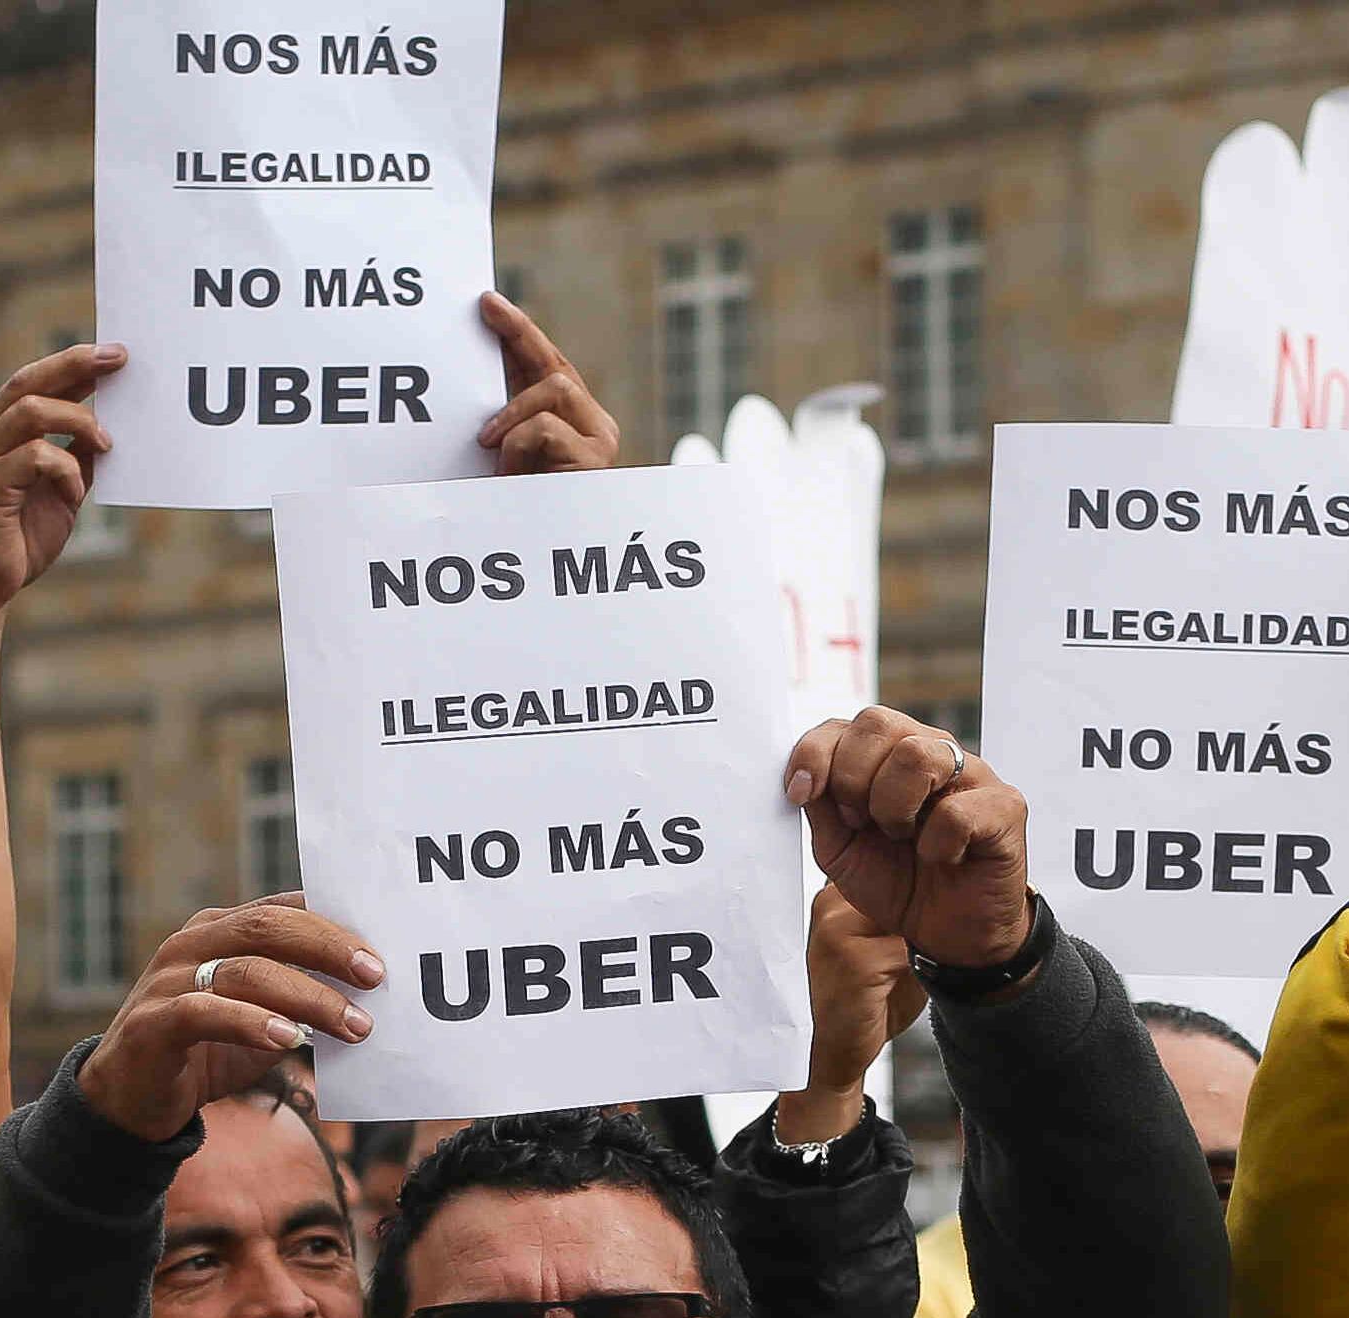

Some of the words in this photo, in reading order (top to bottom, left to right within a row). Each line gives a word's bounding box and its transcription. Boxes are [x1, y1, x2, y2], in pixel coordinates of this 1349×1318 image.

[176, 33, 300, 75] NOS
[320, 25, 438, 77] MÁS
[176, 151, 431, 183] ILEGALIDAD
[193, 268, 281, 309] NO
[304, 257, 424, 308] MÁS
[187, 365, 433, 427] UBER
[1067, 488, 1201, 533] NOS
[368, 551, 525, 609] NOS
[551, 530, 706, 597] MÁS
[381, 678, 715, 737] ILEGALIDAD
[1081, 727, 1172, 771] NO
[1197, 722, 1332, 776] MÁS
[415, 829, 521, 884] NO
[547, 807, 705, 874] MÁS
[1074, 828, 1334, 896] UBER
[418, 931, 721, 1022] UBER
